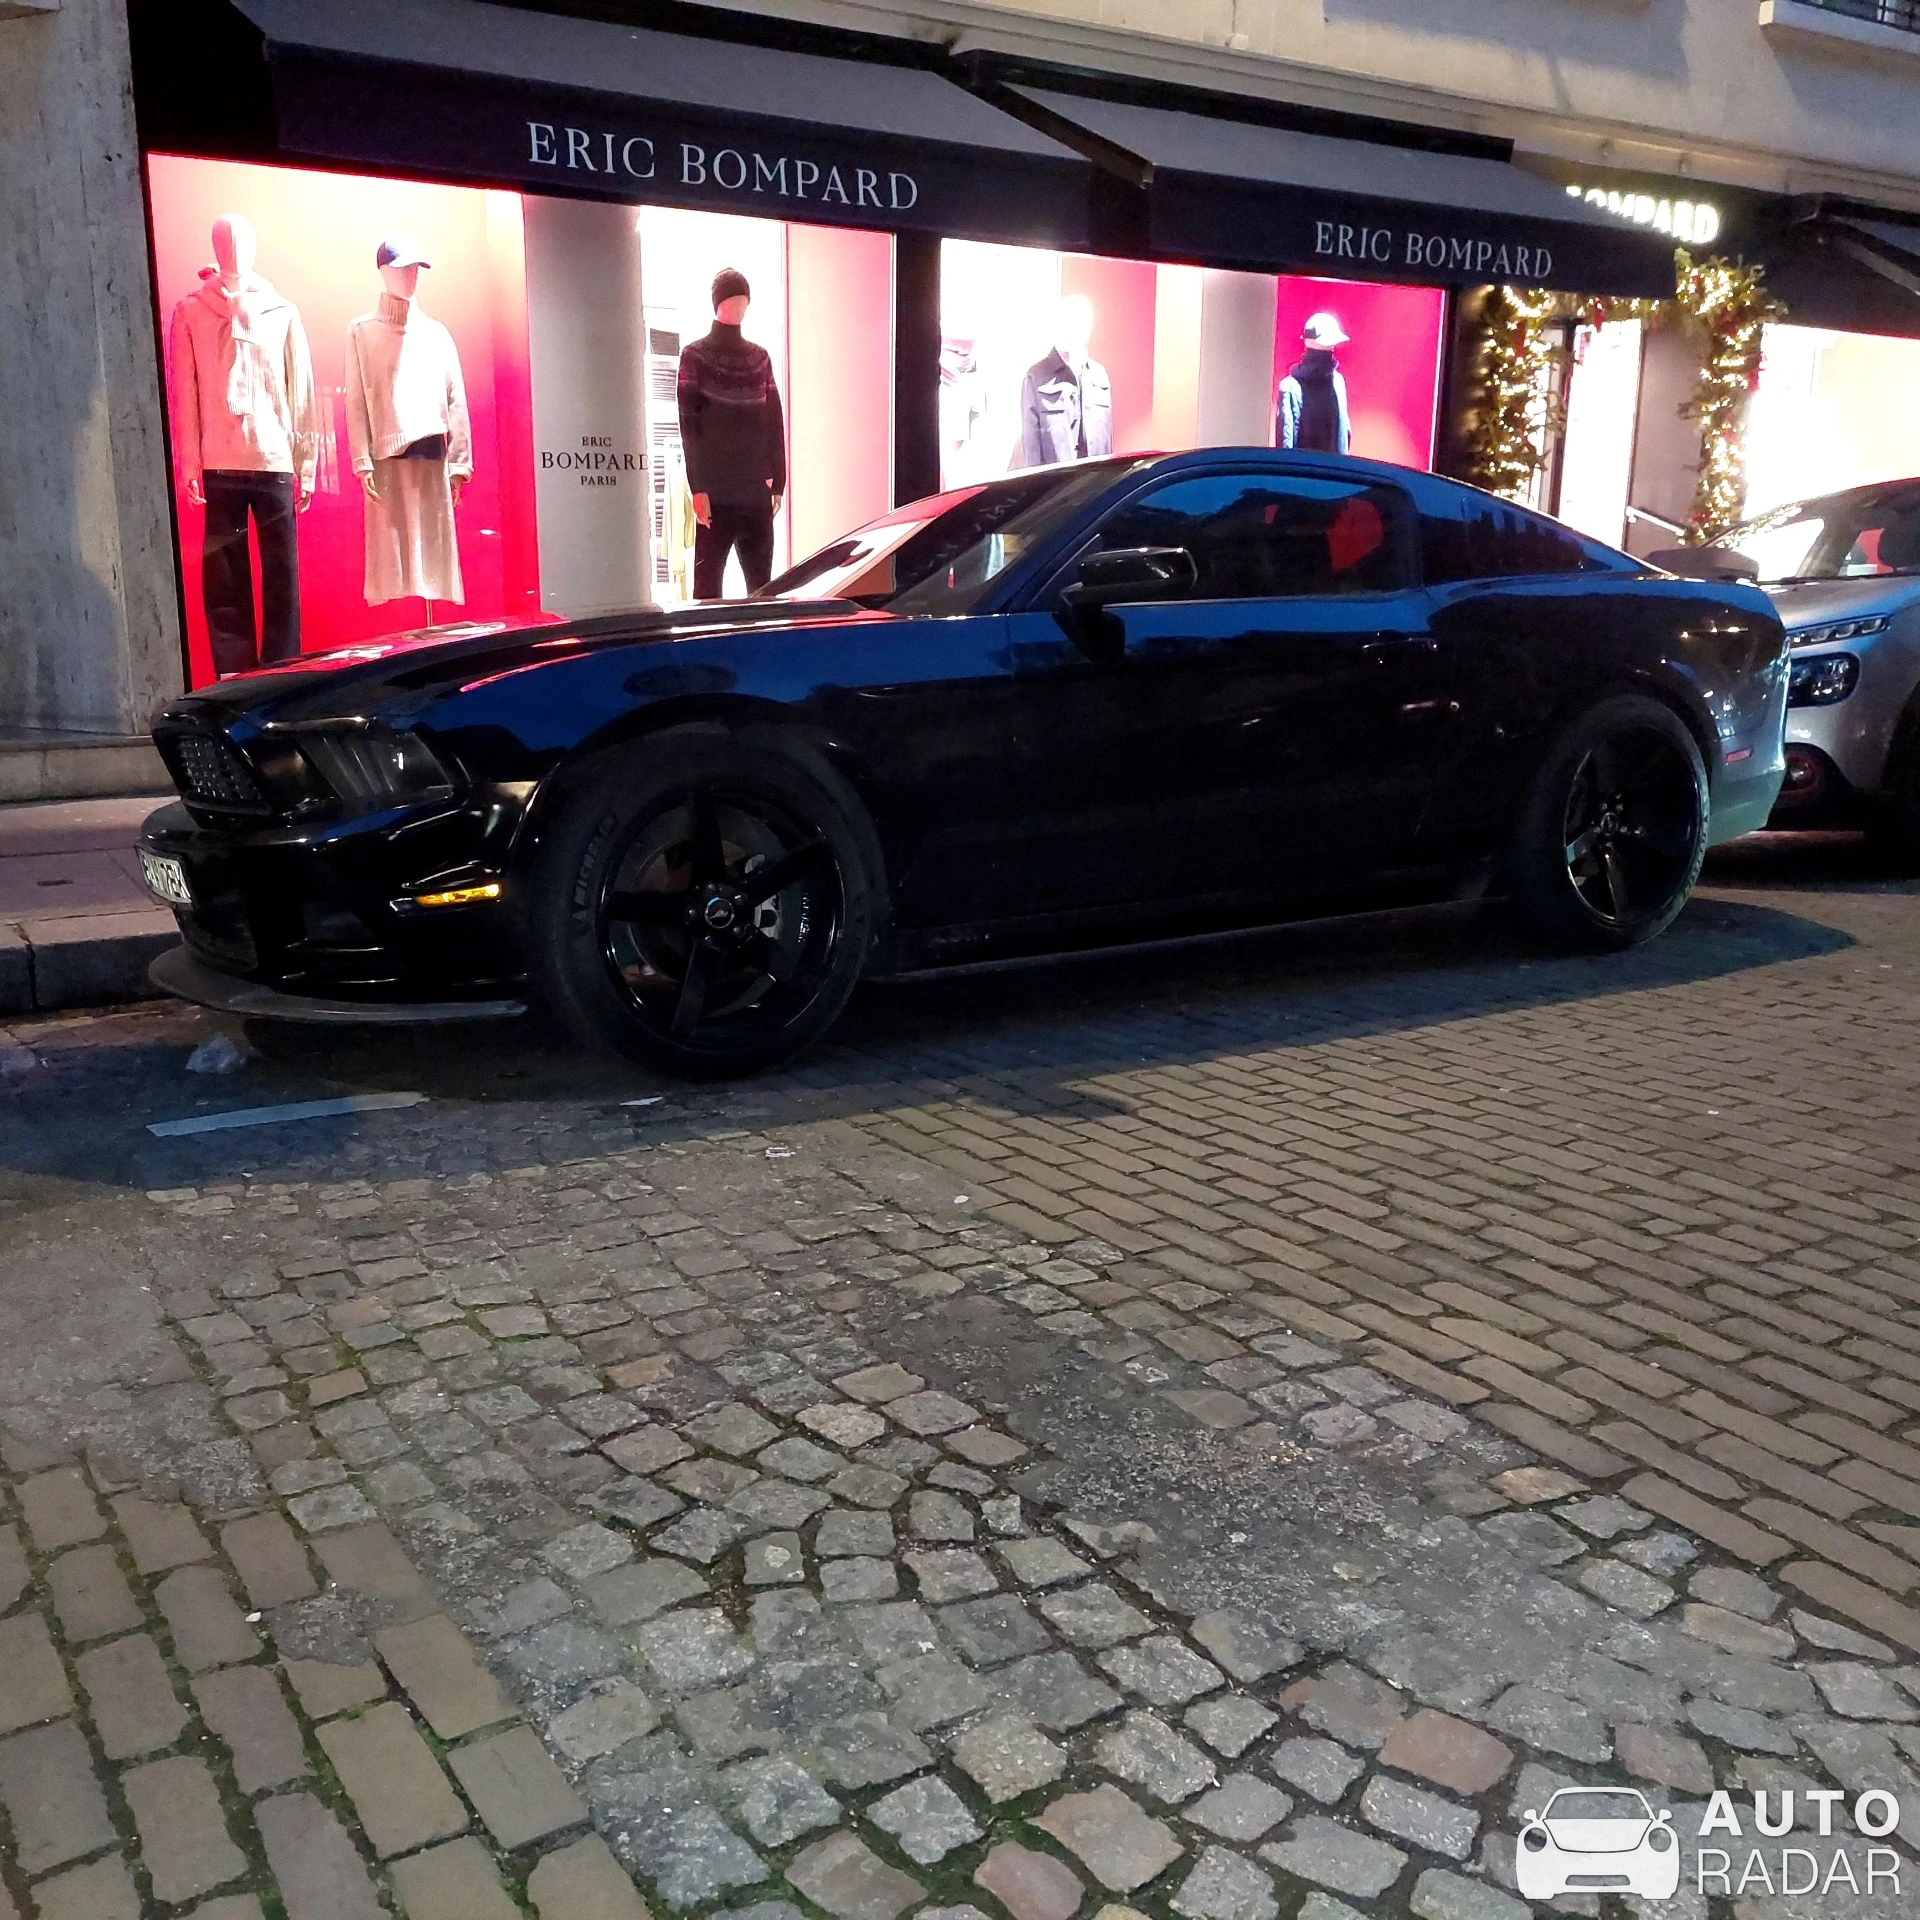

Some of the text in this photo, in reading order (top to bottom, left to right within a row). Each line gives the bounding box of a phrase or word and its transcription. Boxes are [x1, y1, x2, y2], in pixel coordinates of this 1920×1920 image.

[526, 122, 918, 210] ERIC BOMPARD
[1315, 221, 1552, 279] ERIC BOMPARD
[582, 436, 612, 447] ERIC
[541, 451, 650, 471] BOMPARD
[580, 475, 617, 486] PARIS
